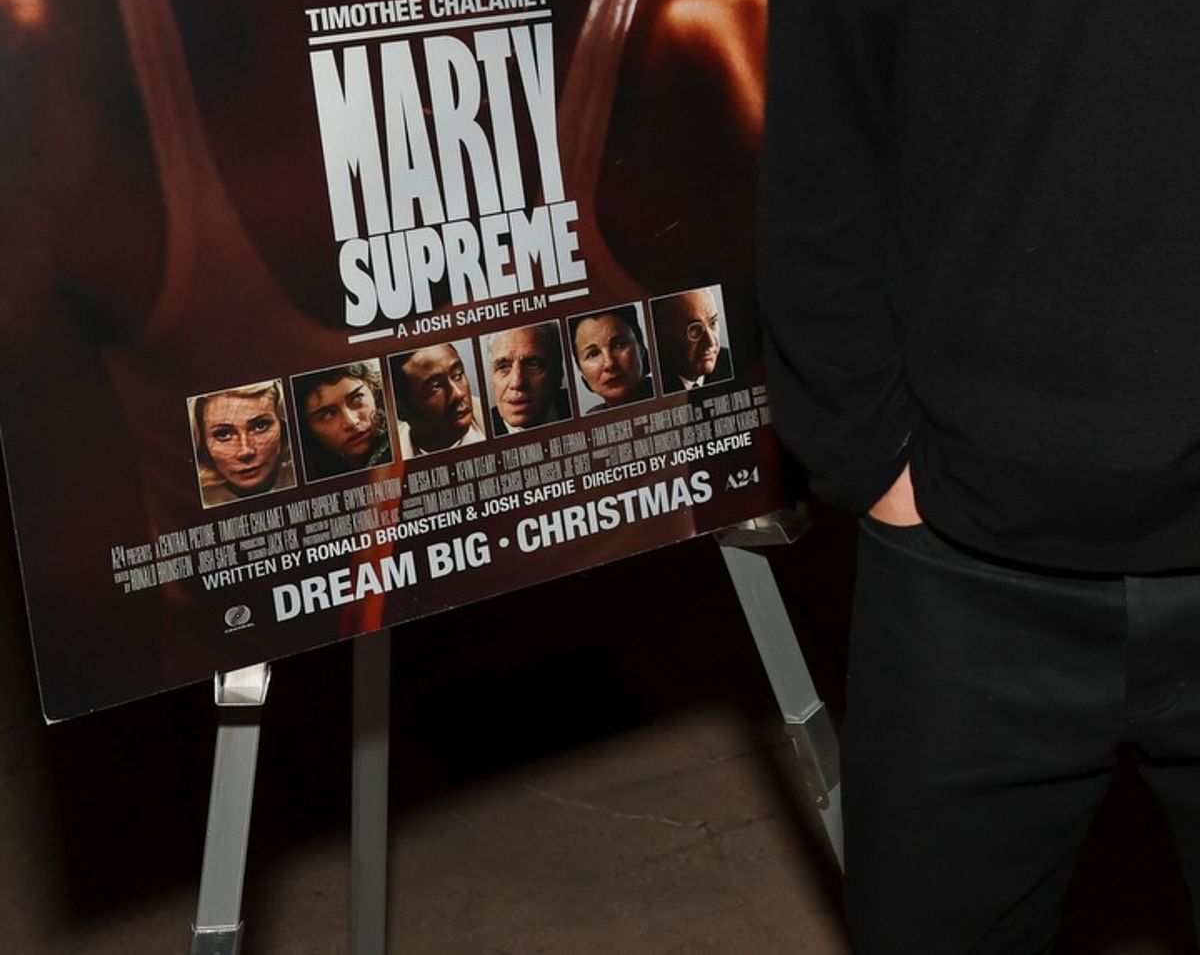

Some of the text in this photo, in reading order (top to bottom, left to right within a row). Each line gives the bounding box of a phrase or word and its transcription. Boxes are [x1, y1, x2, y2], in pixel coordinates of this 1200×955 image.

[309, 22, 566, 242] MARTY
[339, 200, 588, 327] SUPREME
[396, 294, 548, 339] A JOSH SAFDIE FILM
[202, 558, 277, 590] WRITTEN
[281, 550, 302, 570] BY
[306, 534, 372, 563] RONALD
[375, 509, 462, 545] BRONSTEIN
[465, 506, 478, 521] &
[481, 494, 520, 517] JOSH
[523, 479, 576, 505] SAFDIE
[582, 460, 647, 490] DIRECTED
[649, 454, 666, 472] BY
[670, 445, 704, 467] JOSH
[706, 431, 752, 456] SAFDIE
[272, 550, 418, 623] DREAM
[427, 530, 491, 579] BIG
[516, 470, 713, 554] CHRISTMAS
[724, 466, 760, 492] A24
